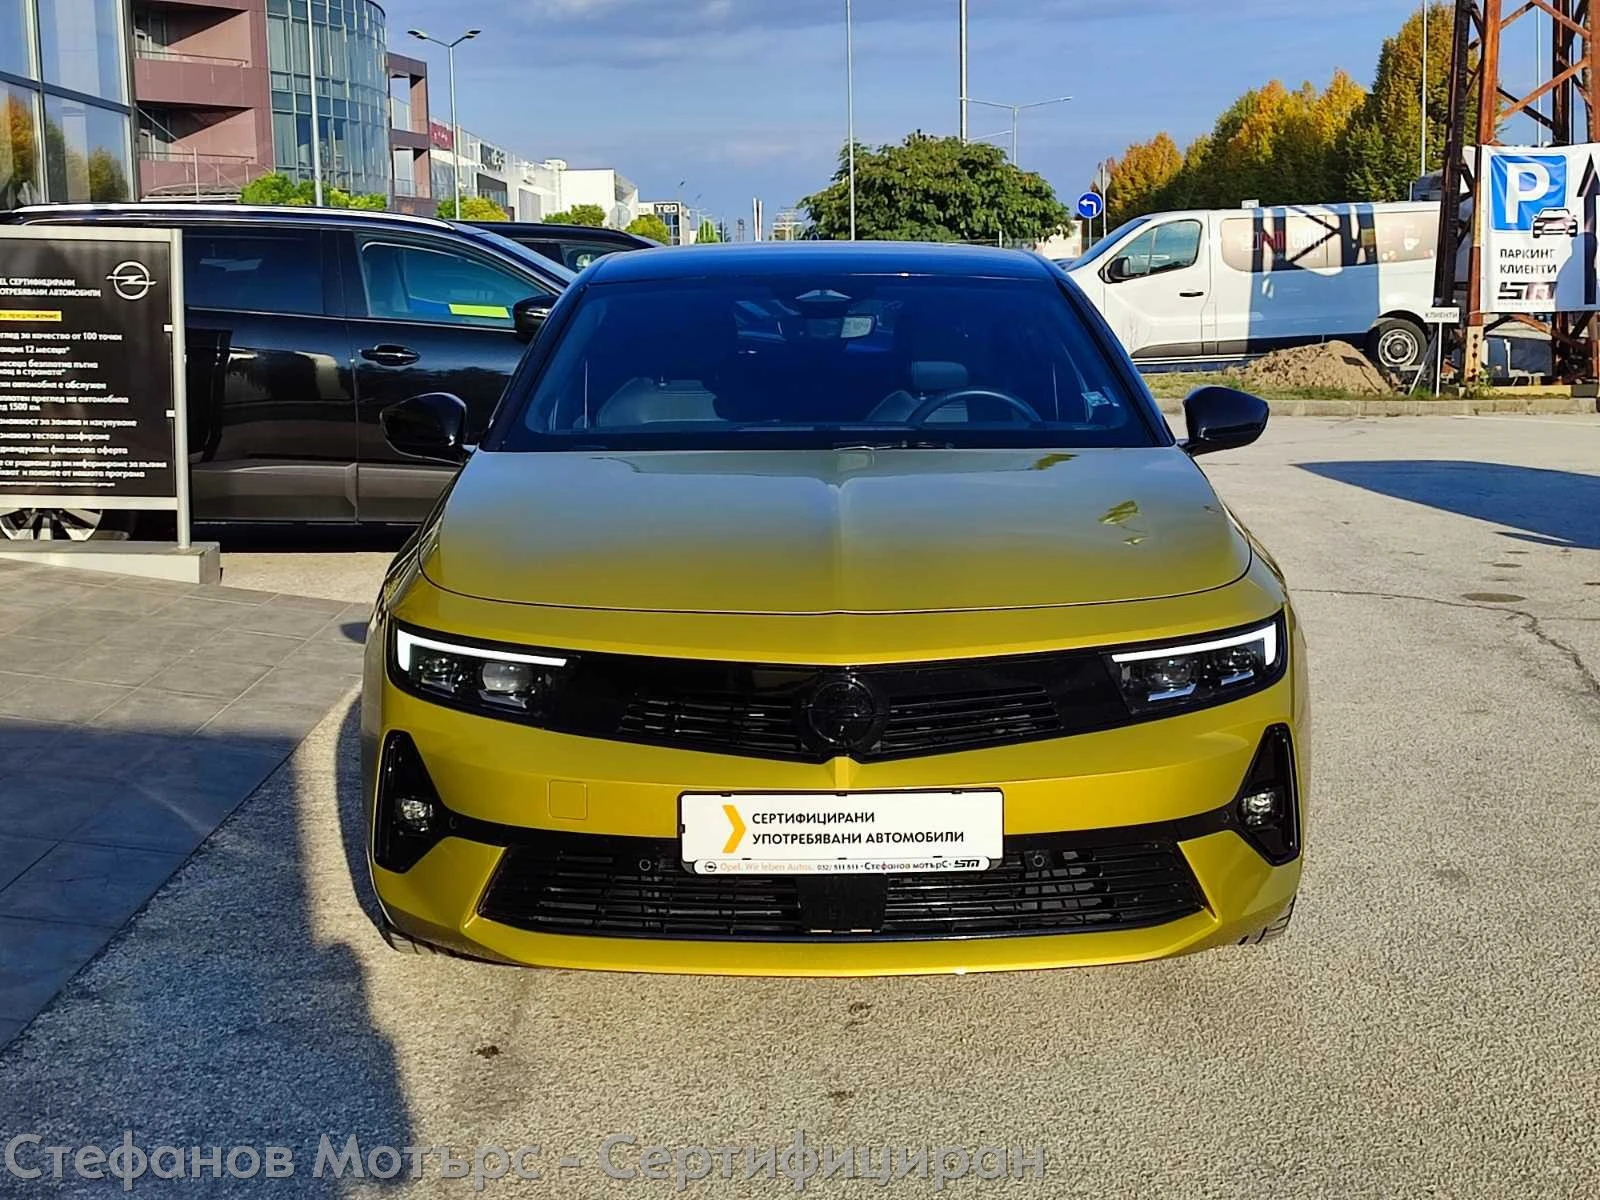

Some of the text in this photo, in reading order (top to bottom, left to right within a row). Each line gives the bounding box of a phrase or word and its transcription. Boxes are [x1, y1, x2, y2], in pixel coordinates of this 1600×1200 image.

[1505, 162, 1550, 224] P
[1500, 248, 1555, 259] ПАРКИНГ
[1500, 264, 1557, 274] КЛИЕНТИ
[83, 332, 97, 340] 100
[25, 345, 34, 353] 12
[9, 402, 28, 411] 1500
[752, 811, 876, 825] СЕРТИФИЦИРАНИ
[752, 831, 965, 845] УПОТРЕБЯВАНИ АВТОМОБИЛИ
